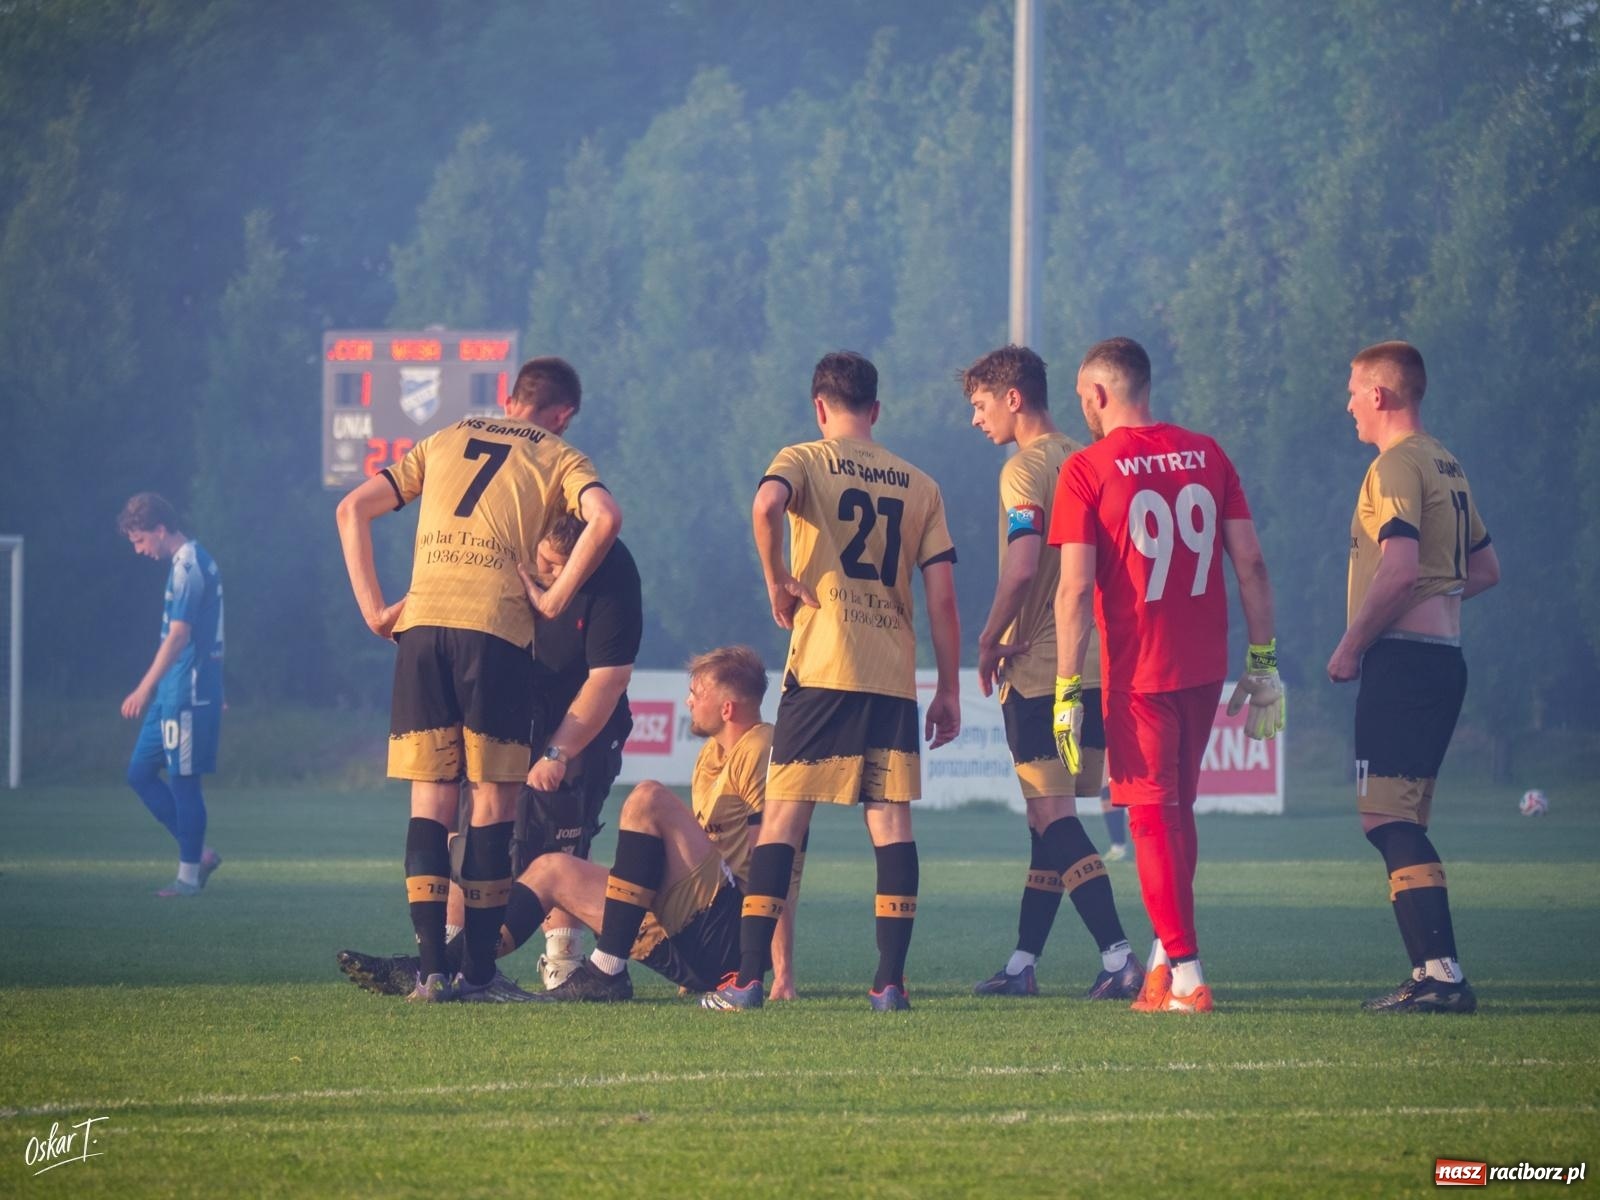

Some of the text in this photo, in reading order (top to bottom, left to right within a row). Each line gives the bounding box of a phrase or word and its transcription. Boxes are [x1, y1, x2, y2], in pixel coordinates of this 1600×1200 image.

[829, 458, 856, 476] LKS
[1115, 450, 1206, 477] WYTRZY
[454, 438, 513, 518] 7
[436, 530, 453, 544] lat
[1128, 483, 1217, 603] 99
[427, 549, 505, 570] 1936/2026
[829, 587, 848, 602] 90
